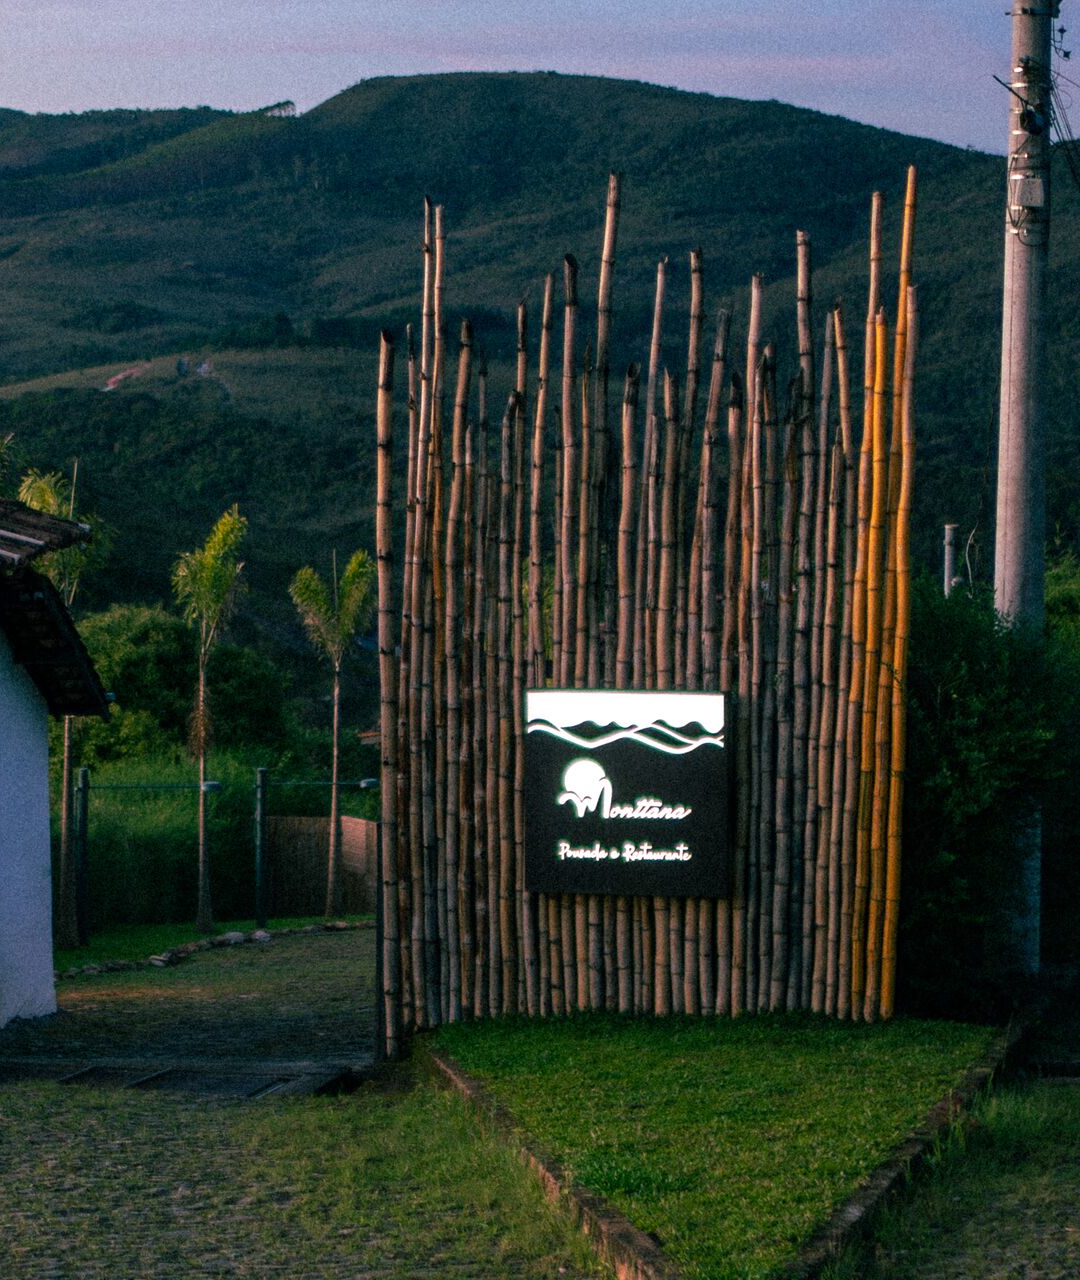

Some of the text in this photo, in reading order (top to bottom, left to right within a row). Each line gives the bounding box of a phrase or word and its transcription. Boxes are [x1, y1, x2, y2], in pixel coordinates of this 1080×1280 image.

[557, 776, 692, 819] Monttana
[558, 840, 692, 862] Pousada e Restaurante
